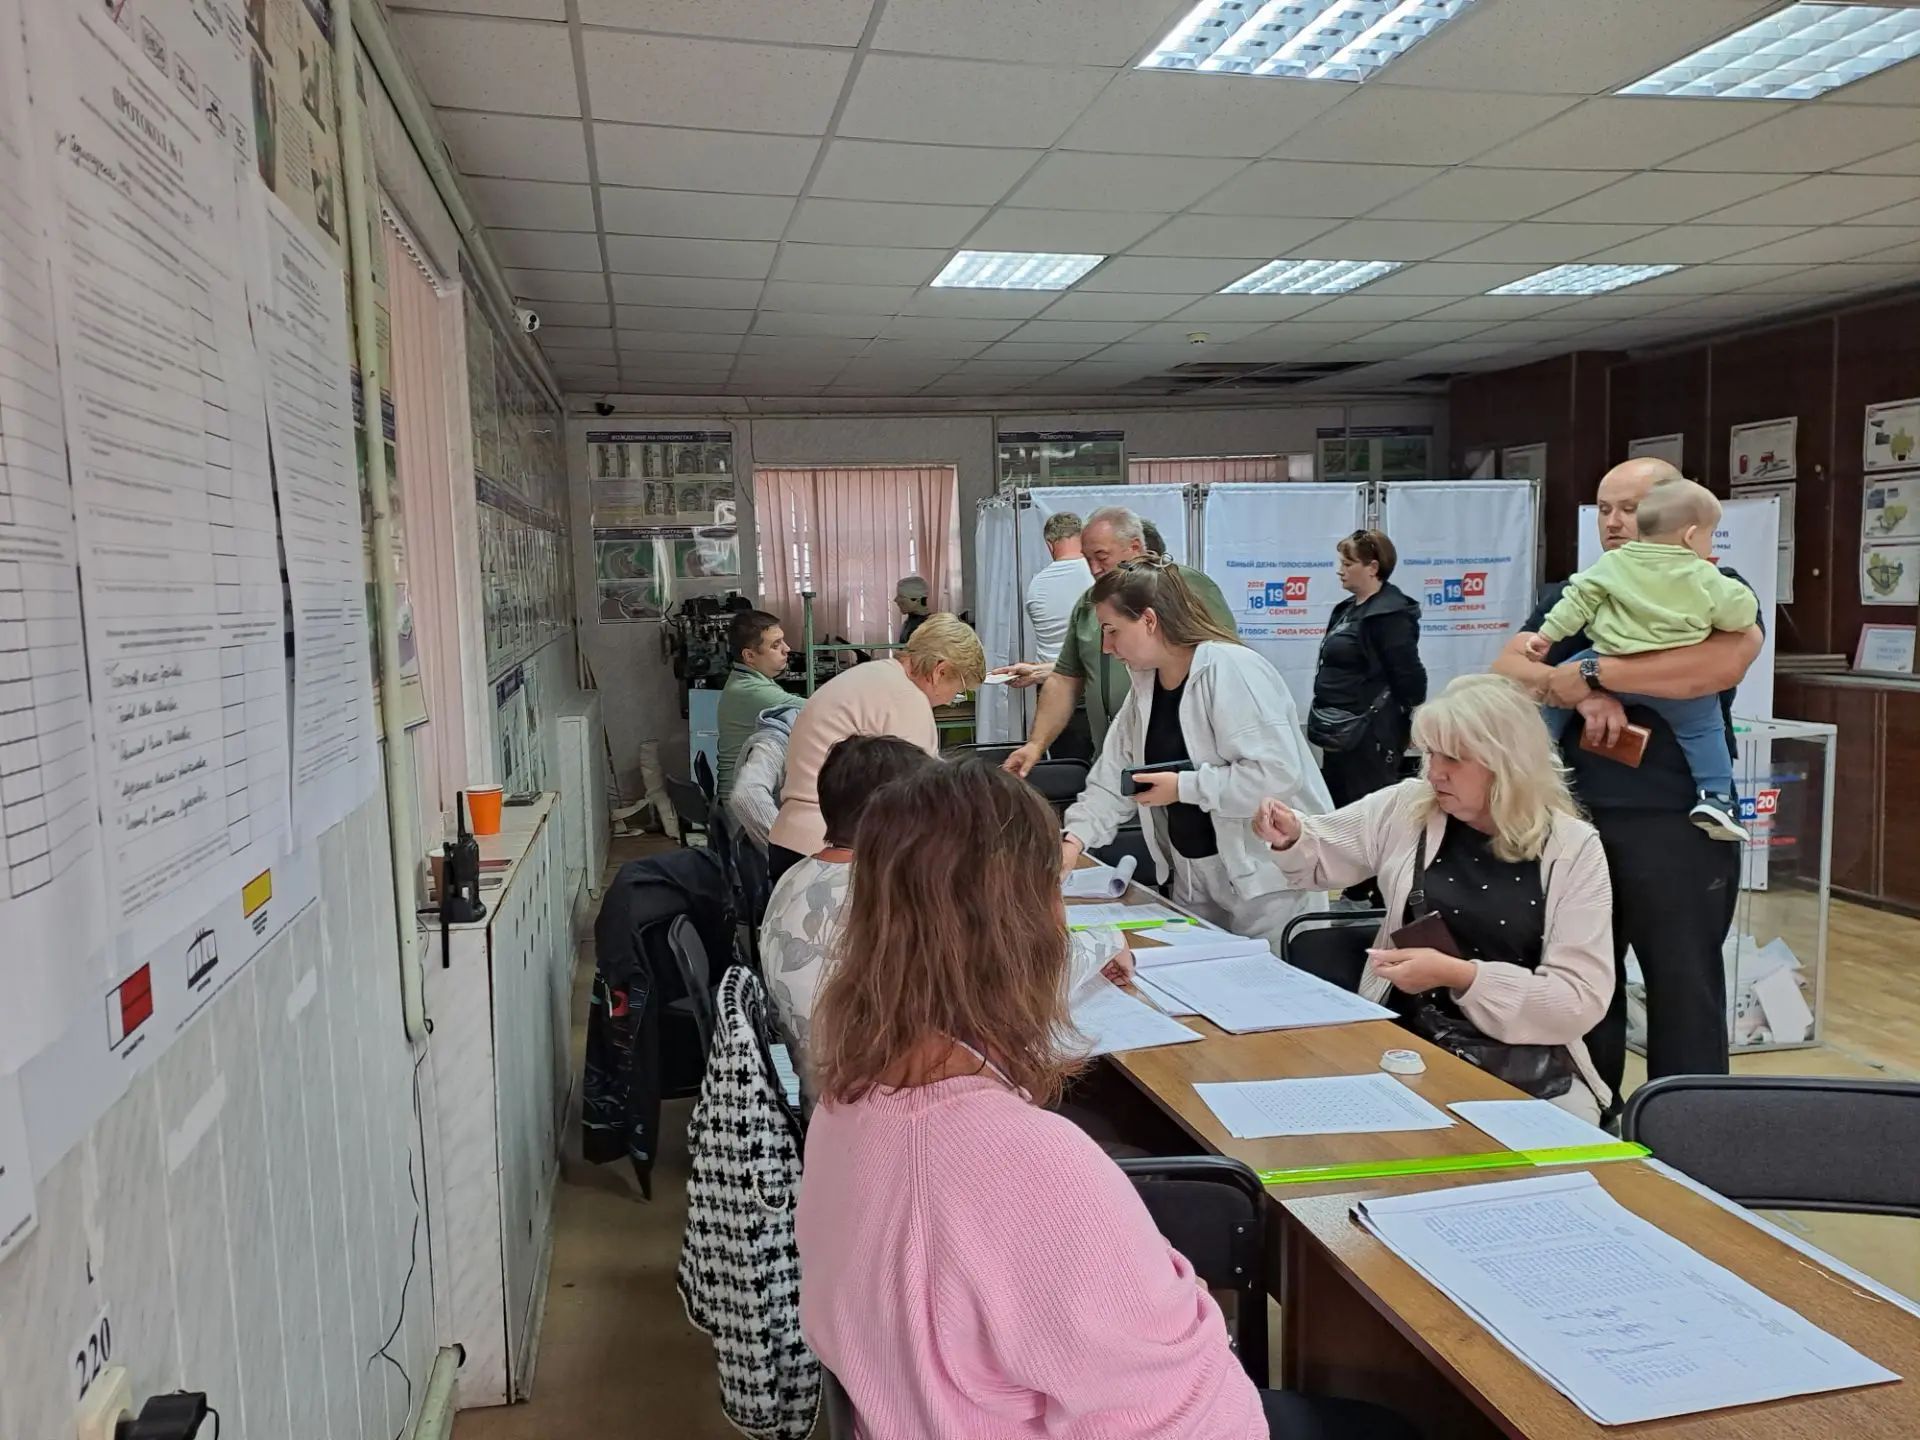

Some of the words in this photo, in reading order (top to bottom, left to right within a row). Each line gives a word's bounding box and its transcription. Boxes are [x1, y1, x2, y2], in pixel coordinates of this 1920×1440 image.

[1226, 560, 1254, 568] ЕДИНЫЙ
[1255, 561, 1277, 569] ДЕНЬ
[1279, 560, 1334, 569] ГОЛОСОВАНИЯ
[1403, 558, 1432, 566] ЕДИНЫЙ
[1433, 558, 1455, 566] ДЕНЬ
[1456, 556, 1511, 565] ГОЛОСОВАНИЯ
[1249, 596, 1264, 609] 18
[1268, 588, 1283, 602] 19
[1286, 582, 1305, 595] 20
[1427, 593, 1443, 606] 18
[1446, 584, 1461, 598] 19
[1464, 578, 1483, 591] 20
[1268, 608, 1308, 616] СЕНТЯБРЯ
[1244, 627, 1268, 635] ГОЛОС
[1276, 627, 1297, 635] СИЛА
[1455, 623, 1476, 631] СИЛА
[1740, 802, 1755, 816] 19
[1758, 795, 1775, 809] 20
[75, 1317, 111, 1401] 220
